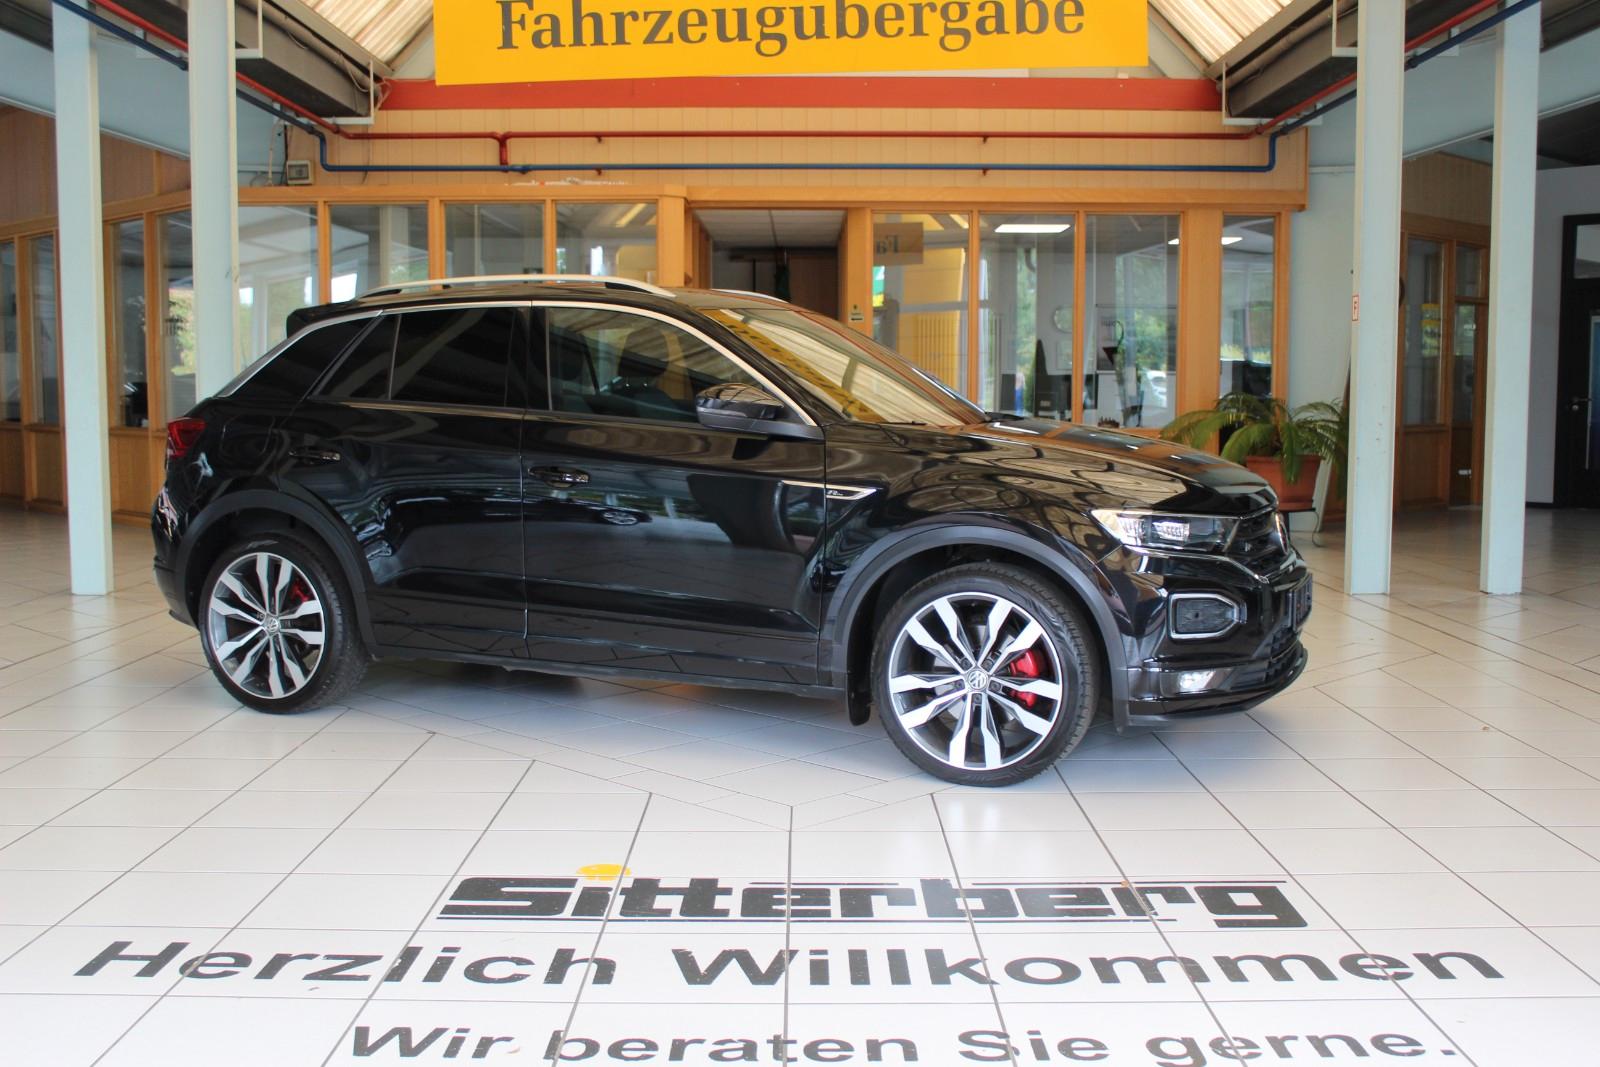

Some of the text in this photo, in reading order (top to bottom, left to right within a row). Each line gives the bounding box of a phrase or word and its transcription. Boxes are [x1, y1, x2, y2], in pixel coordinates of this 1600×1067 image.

[438, 865, 1307, 928] Sitterberg
[75, 941, 1503, 985] Herzlich Willkommen
[353, 1026, 1458, 1067] Wir beraten Sie gerne.
